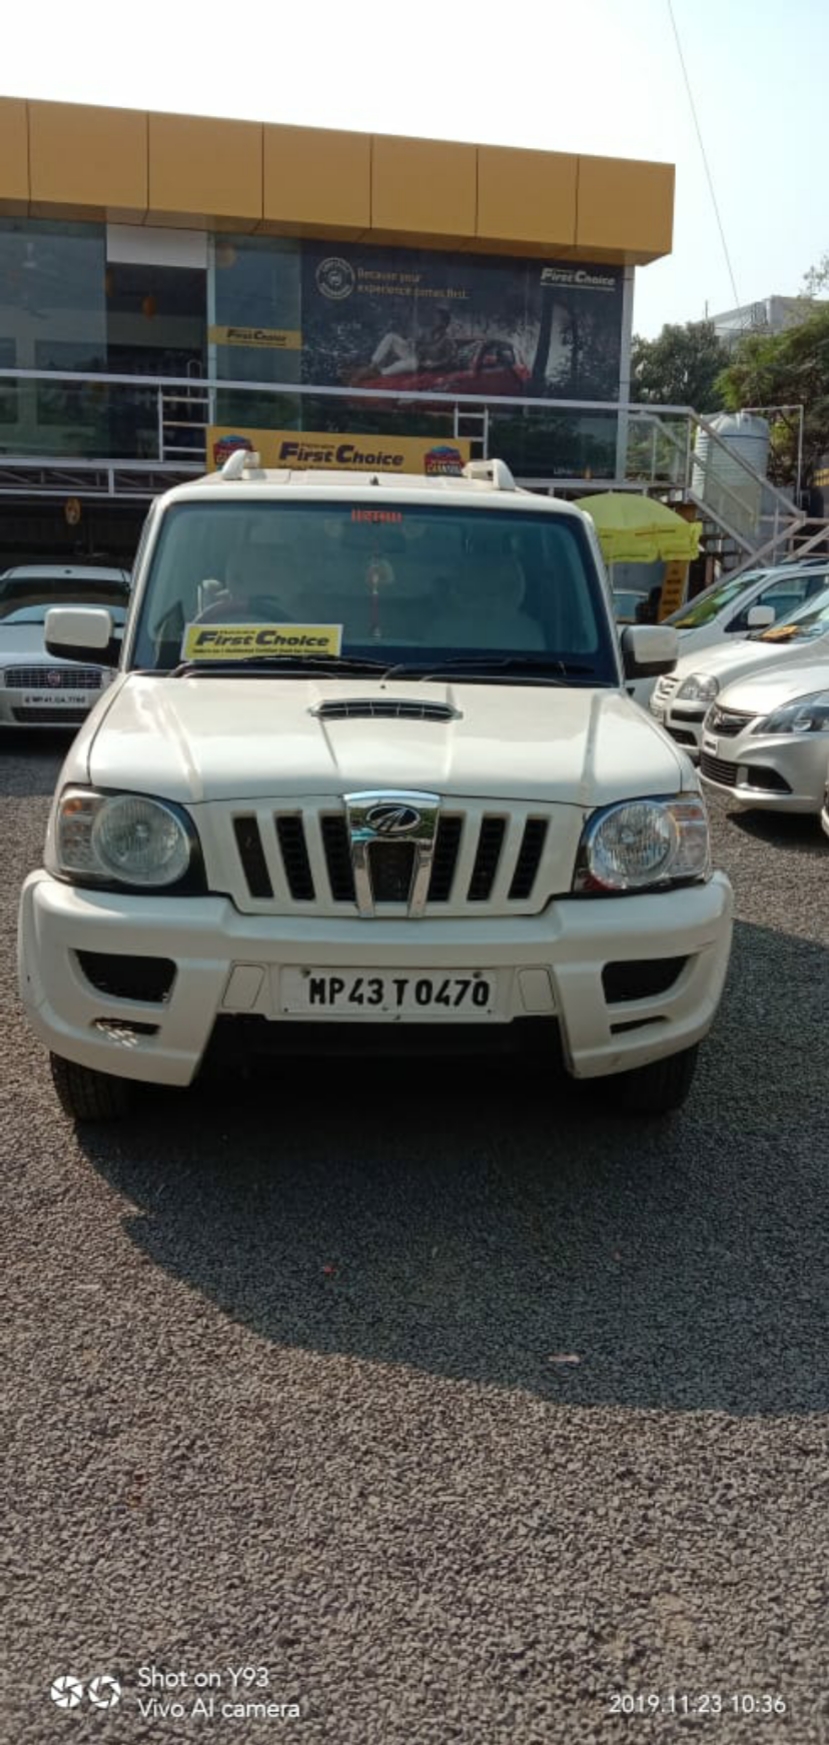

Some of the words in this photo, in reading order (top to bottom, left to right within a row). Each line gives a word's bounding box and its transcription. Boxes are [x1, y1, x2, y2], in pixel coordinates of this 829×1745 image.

[541, 267, 573, 283] First
[574, 270, 616, 286] Choice
[227, 328, 253, 340] First
[278, 441, 334, 462] First
[336, 444, 404, 466] Choice
[195, 630, 253, 646] First
[255, 630, 329, 647] Choice
[415, 979, 490, 1006] 0470
